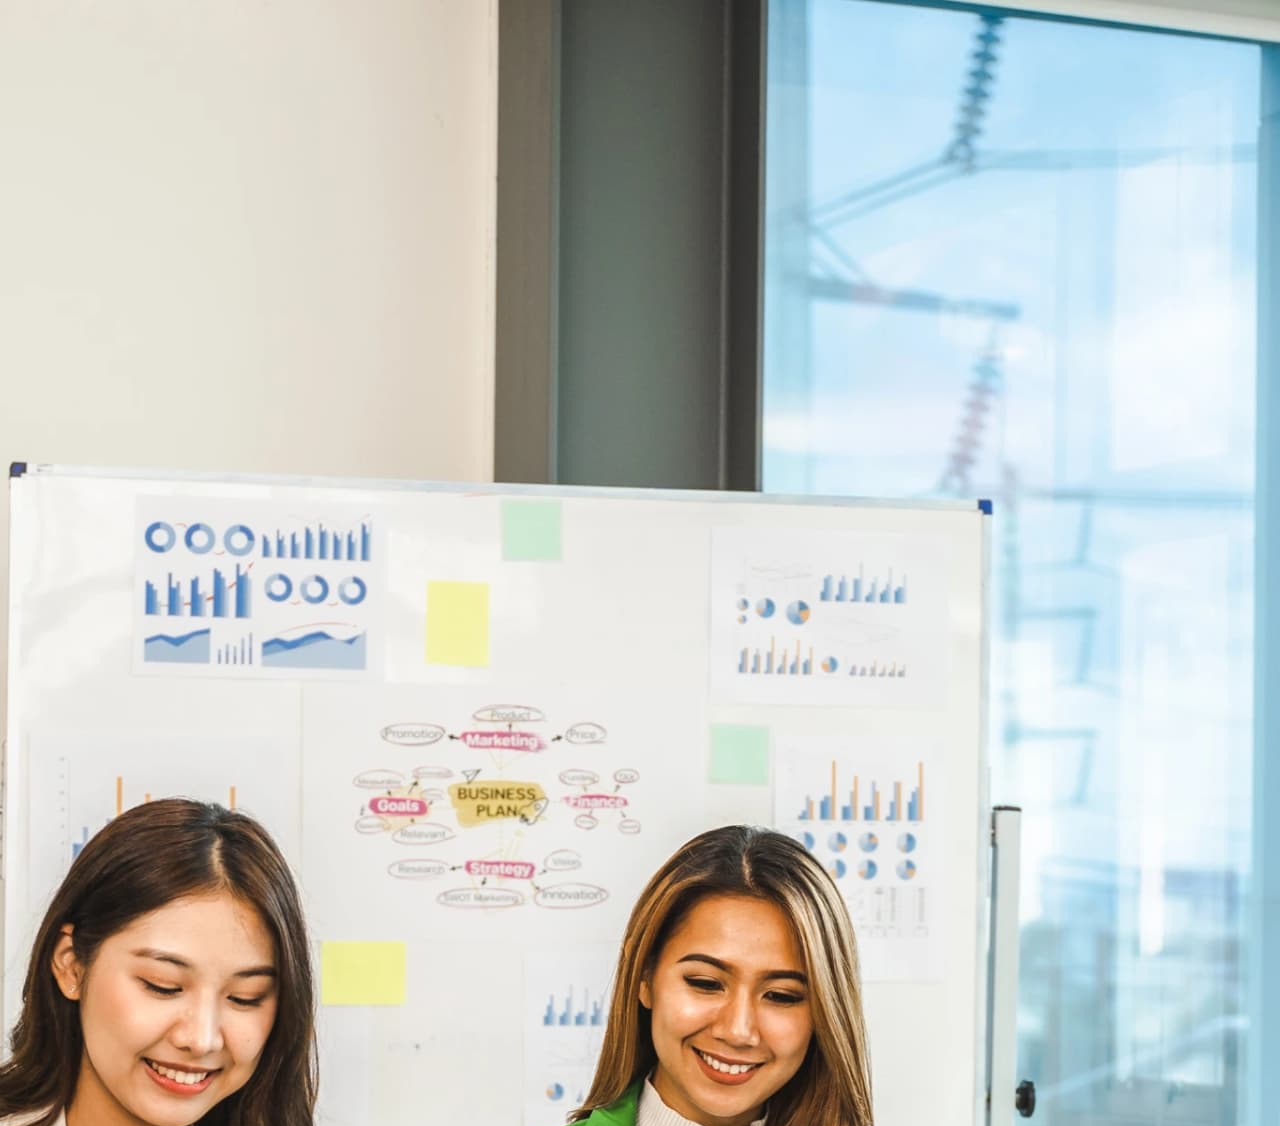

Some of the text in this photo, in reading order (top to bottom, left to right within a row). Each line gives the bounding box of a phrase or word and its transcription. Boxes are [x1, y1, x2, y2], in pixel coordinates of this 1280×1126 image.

[490, 709, 531, 721] Product
[384, 728, 442, 739] Promotion
[569, 729, 597, 739] Price
[466, 734, 539, 750] Marketing
[457, 787, 536, 801] BUSINESS
[376, 799, 421, 813] Goals
[569, 796, 626, 809] Finance
[476, 804, 518, 817] PLAN
[400, 828, 447, 840] Relevant
[398, 863, 445, 875] Research
[470, 862, 531, 879] Strategy
[541, 889, 603, 900] Innovation
